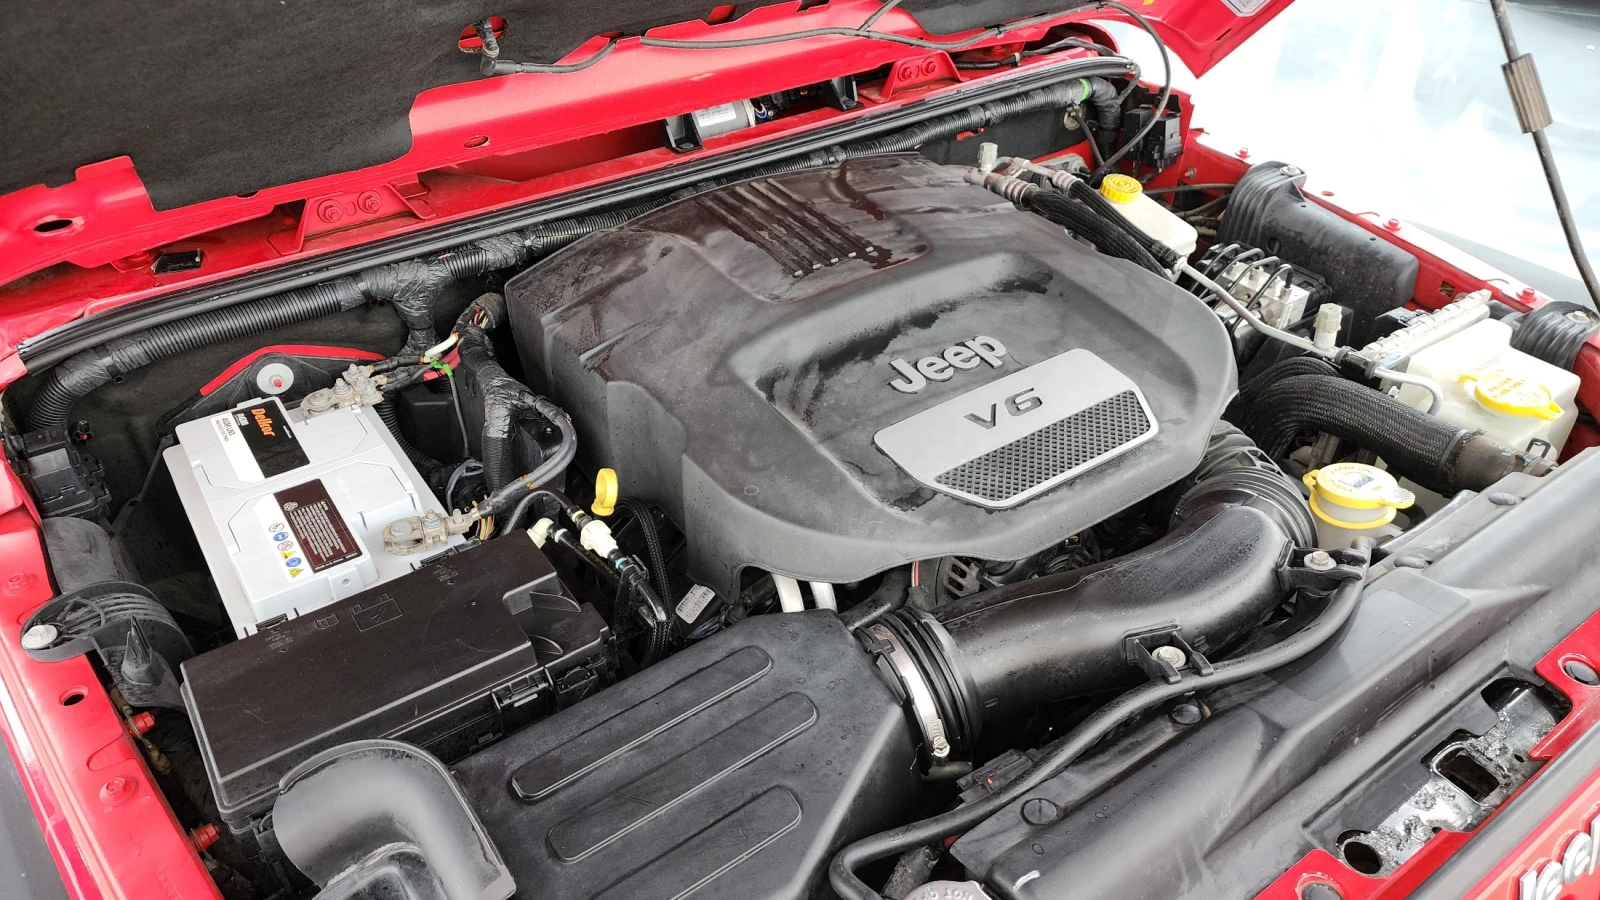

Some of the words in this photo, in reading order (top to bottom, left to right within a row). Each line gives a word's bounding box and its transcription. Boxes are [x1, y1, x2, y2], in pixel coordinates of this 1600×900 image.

[889, 335, 1007, 394] Jeep
[251, 407, 276, 437] Delkor
[963, 386, 1043, 430] V6
